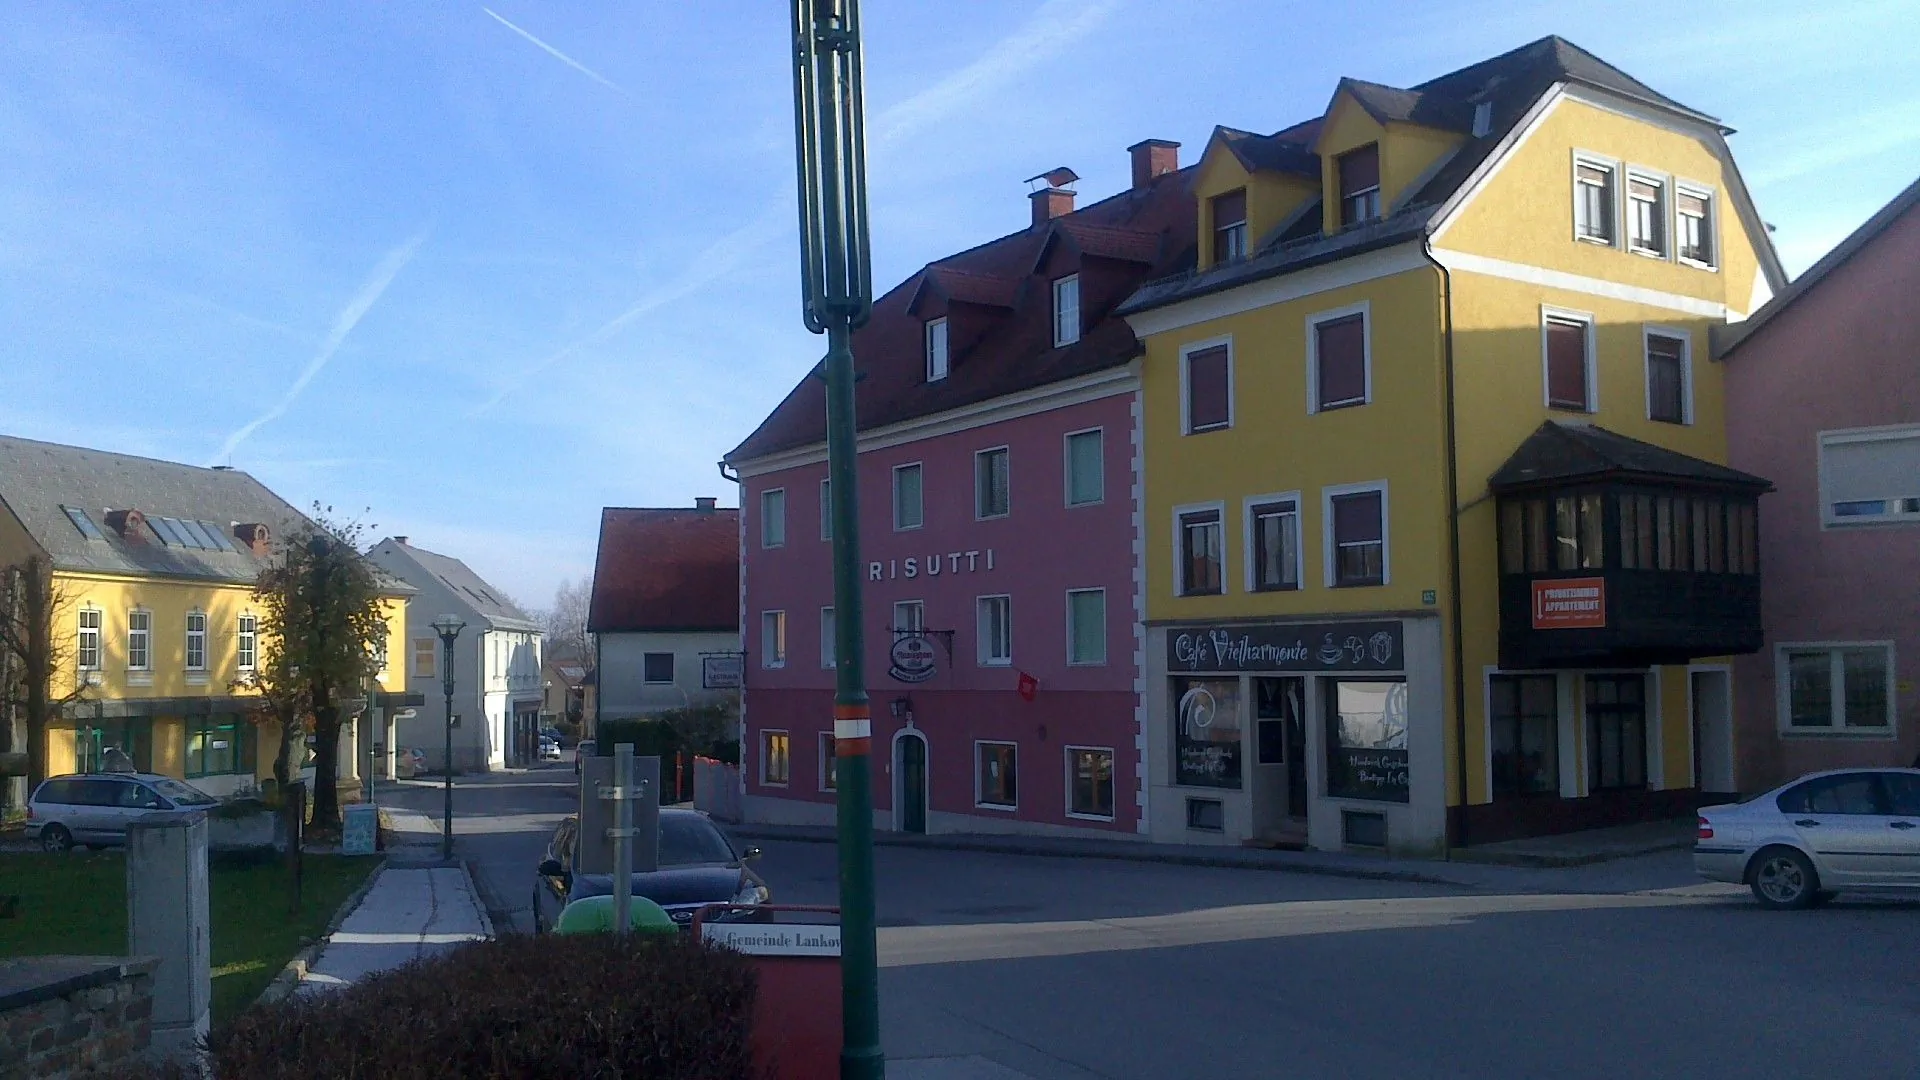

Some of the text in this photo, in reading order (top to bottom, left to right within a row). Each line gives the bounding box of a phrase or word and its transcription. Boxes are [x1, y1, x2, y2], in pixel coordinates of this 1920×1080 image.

[869, 548, 994, 581] RISUTTI
[1175, 632, 1208, 669] Café
[726, 931, 791, 948] Gemeinde
